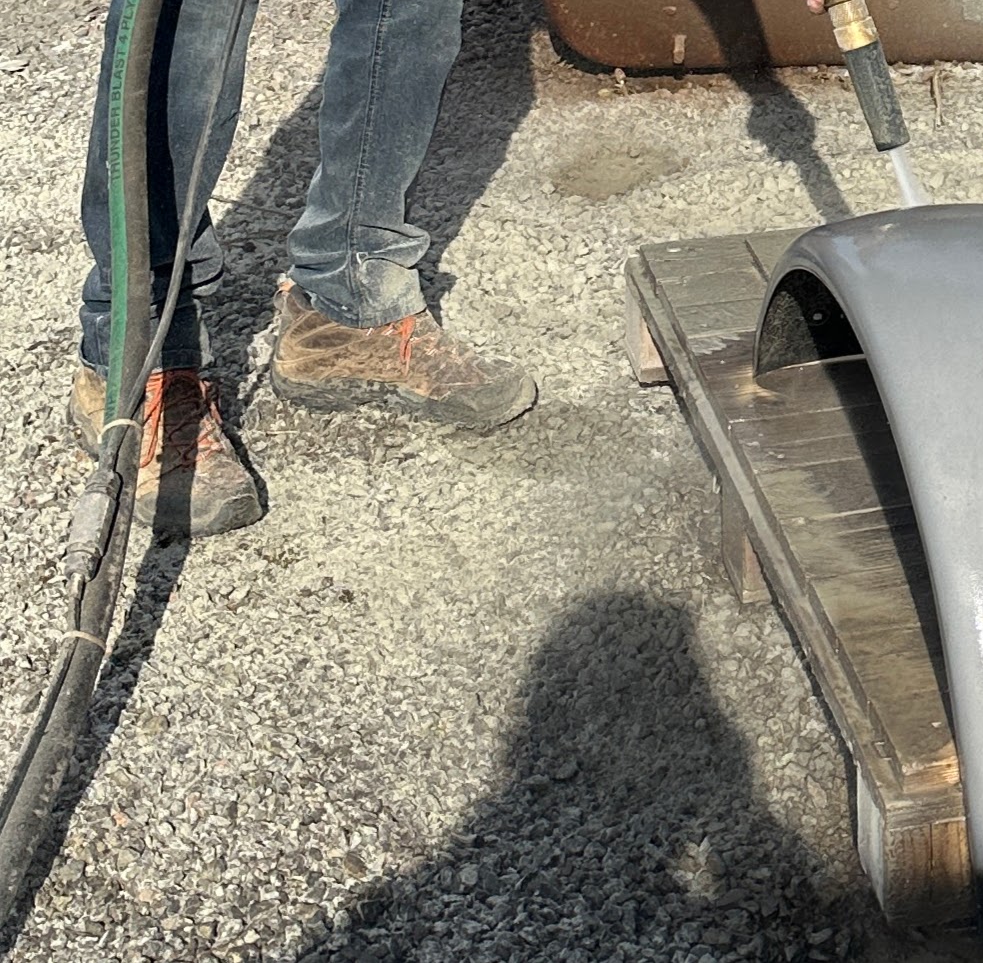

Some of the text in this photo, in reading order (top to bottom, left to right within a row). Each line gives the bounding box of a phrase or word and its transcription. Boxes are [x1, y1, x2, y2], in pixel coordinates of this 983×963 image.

[121, 1, 136, 30] PLY
[119, 33, 128, 44] 4
[112, 51, 126, 102] BLAST
[110, 106, 121, 180] THUNDER
